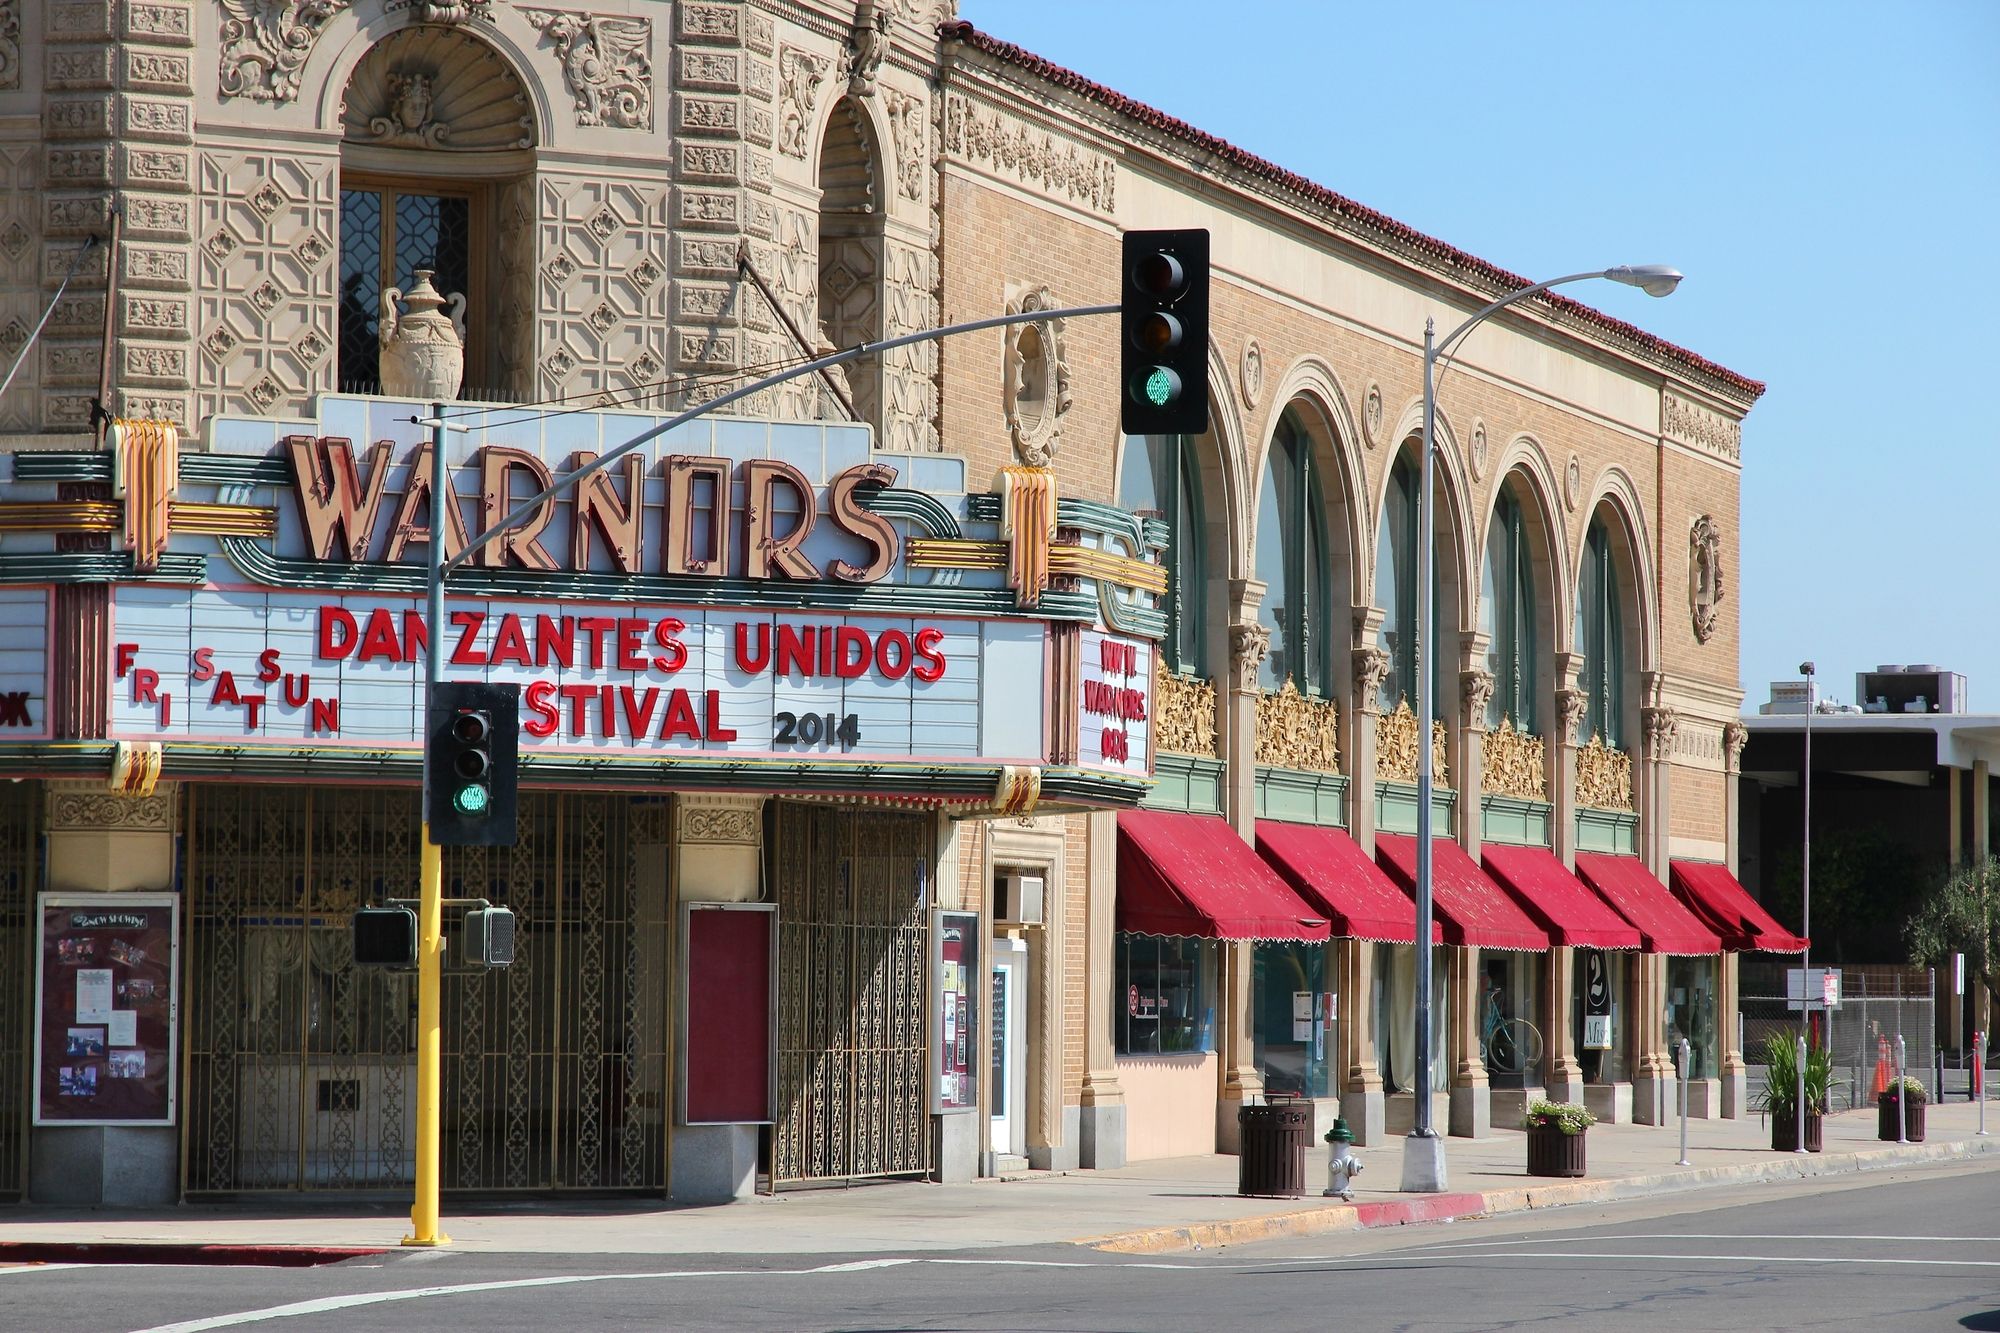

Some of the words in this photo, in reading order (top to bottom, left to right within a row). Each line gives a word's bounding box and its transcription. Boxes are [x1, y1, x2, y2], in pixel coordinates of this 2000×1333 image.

[284, 435, 900, 582] WARNORS
[320, 606, 688, 673] DANZANTES
[735, 622, 946, 682] UNIDOS
[117, 643, 171, 727] FRI
[193, 647, 266, 728] SAT
[259, 649, 338, 732] SUN
[452, 680, 738, 742] STIVAL
[776, 712, 861, 747] 2014
[1101, 727, 1129, 764] ORG
[108, 914, 145, 928] SHOWING
